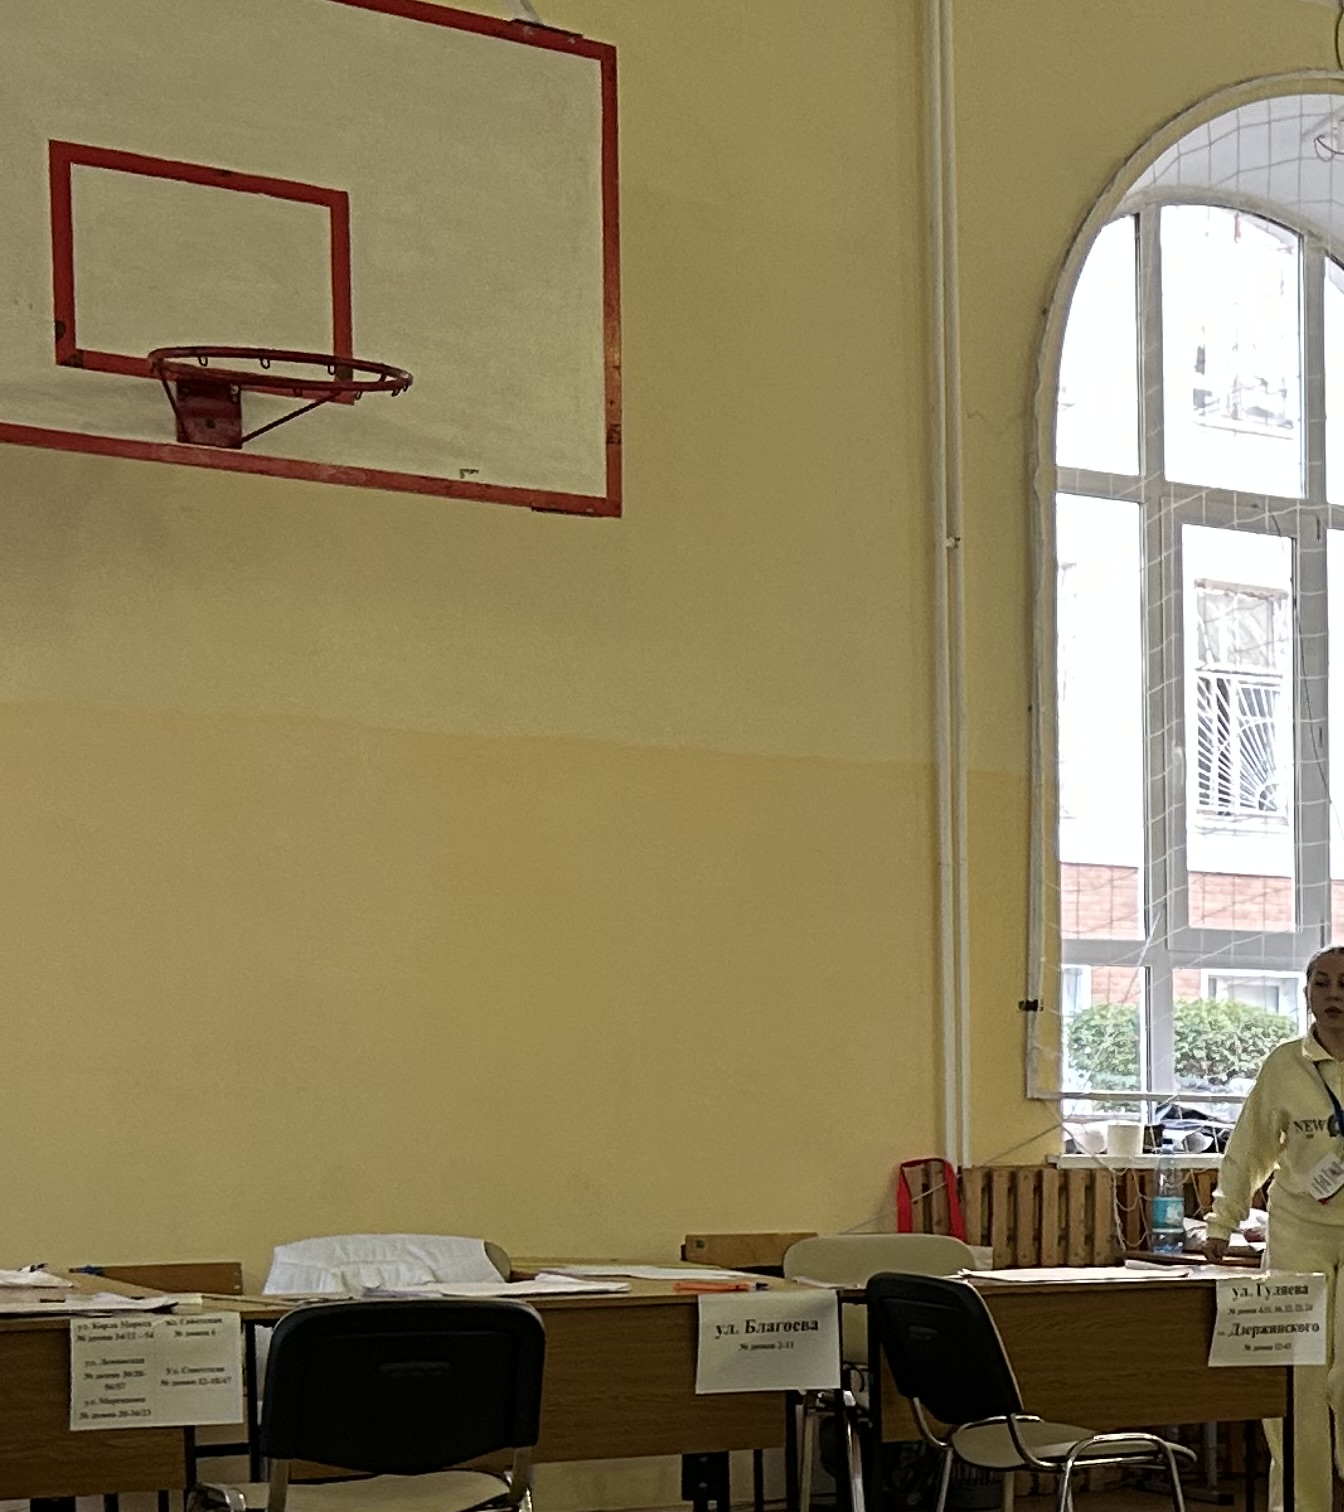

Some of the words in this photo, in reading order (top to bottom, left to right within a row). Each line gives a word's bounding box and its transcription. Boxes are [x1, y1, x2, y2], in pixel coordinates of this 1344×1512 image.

[1293, 1118, 1325, 1133] NEW
[1232, 1287, 1254, 1302] ул.
[714, 1324, 740, 1340] ул.
[744, 1318, 819, 1335] Благоева
